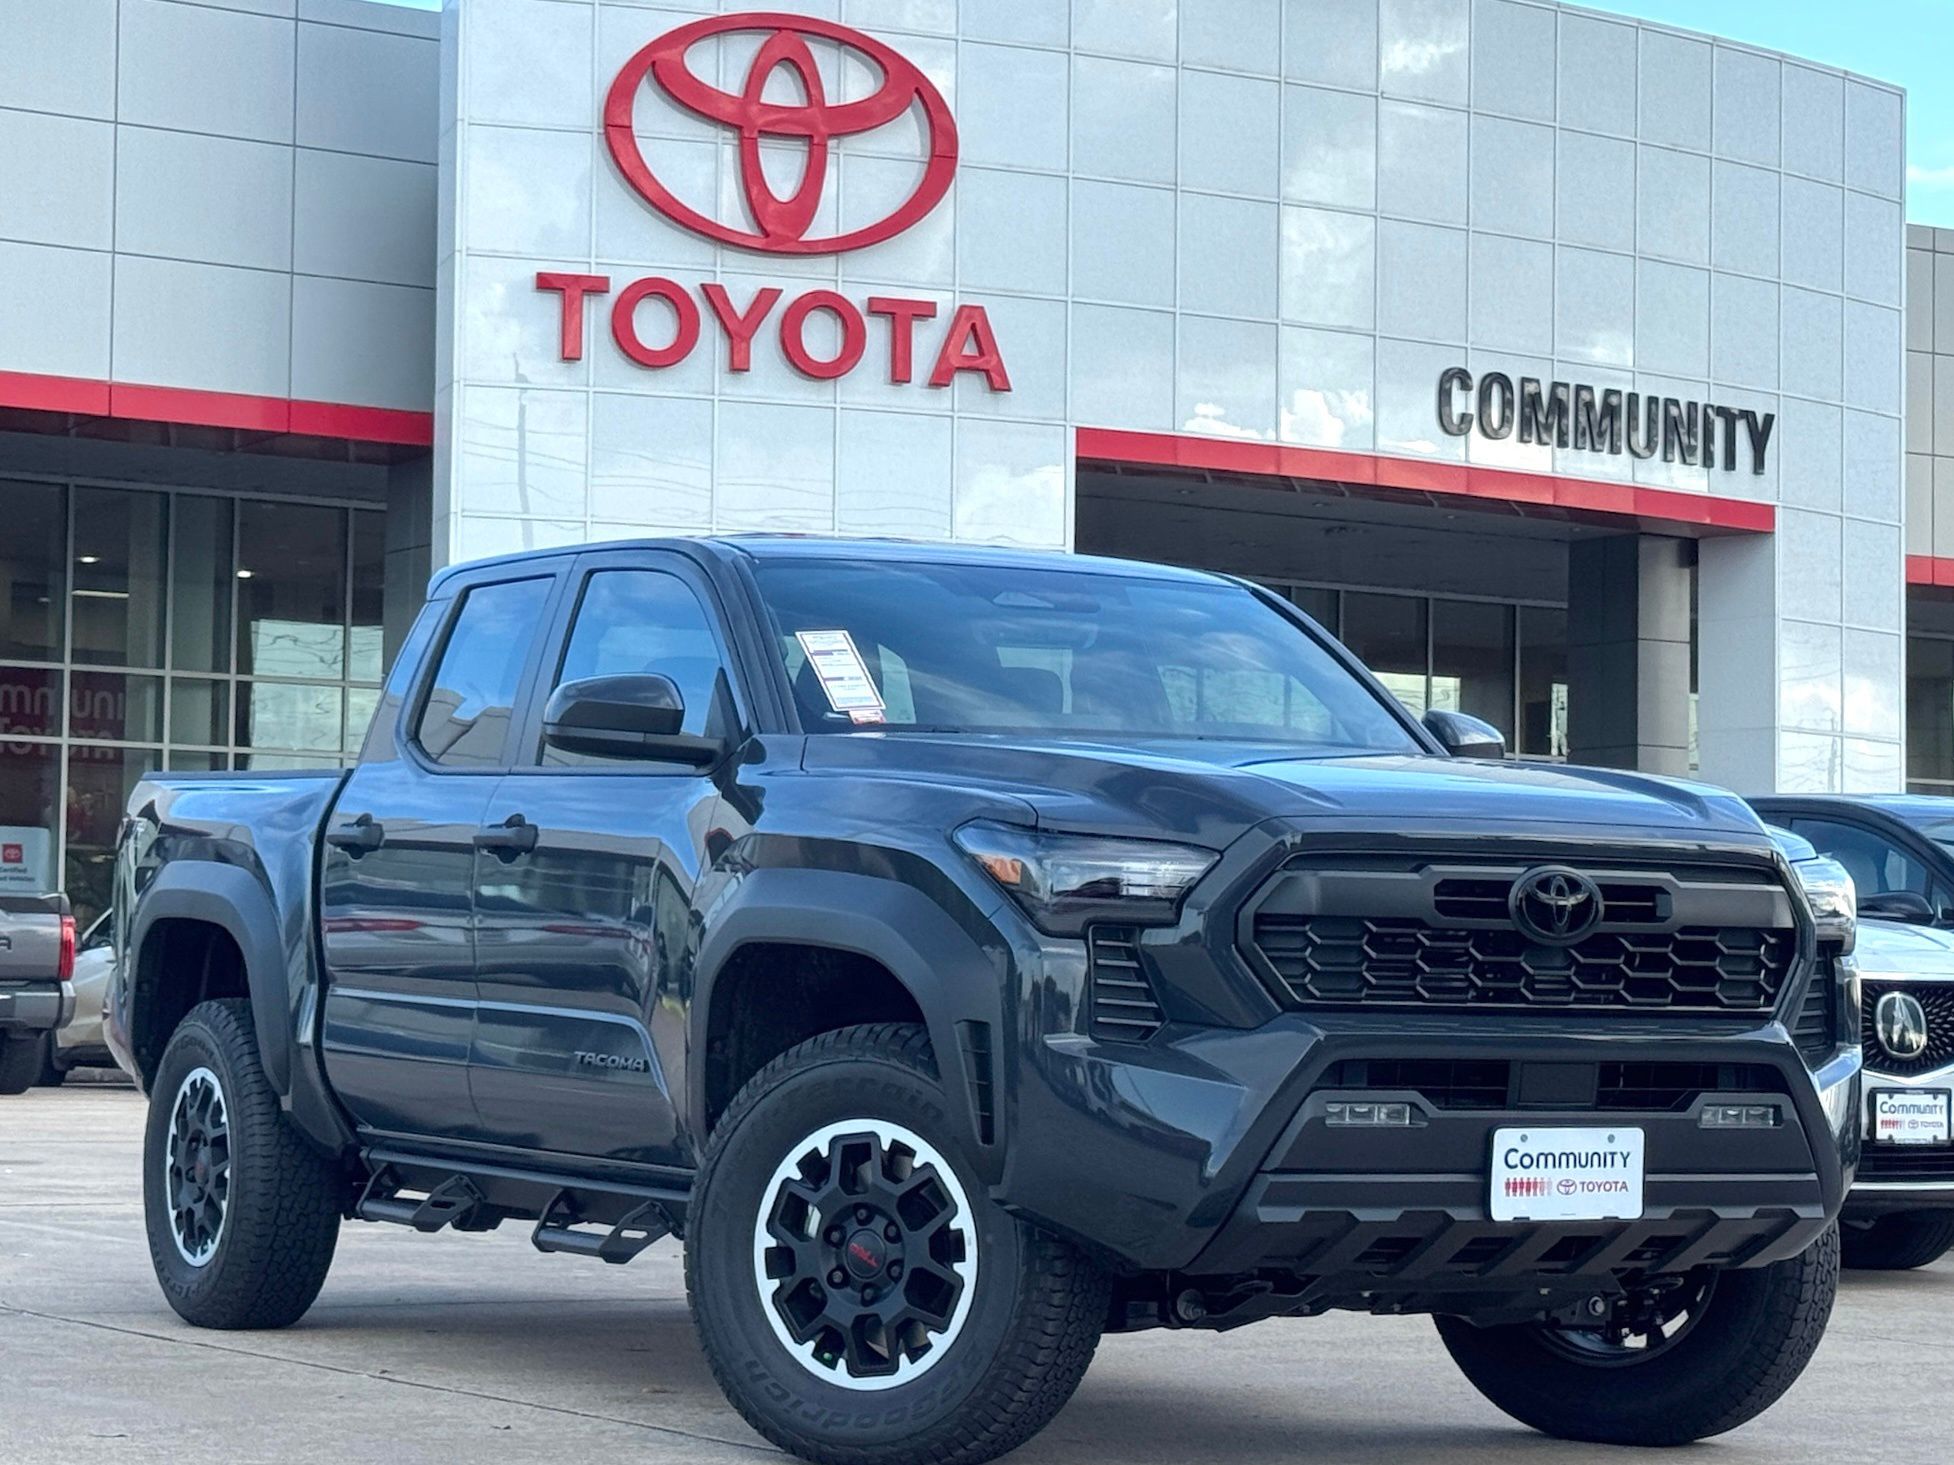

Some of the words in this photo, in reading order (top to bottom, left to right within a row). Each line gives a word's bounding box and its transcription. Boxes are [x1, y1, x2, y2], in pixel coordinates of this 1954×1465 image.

[536, 271, 1012, 392] TOYOTA
[1438, 366, 1776, 475] COMMUNITY
[574, 1051, 645, 1072] TACOMA
[1579, 1181, 1628, 1193] TOYOTA
